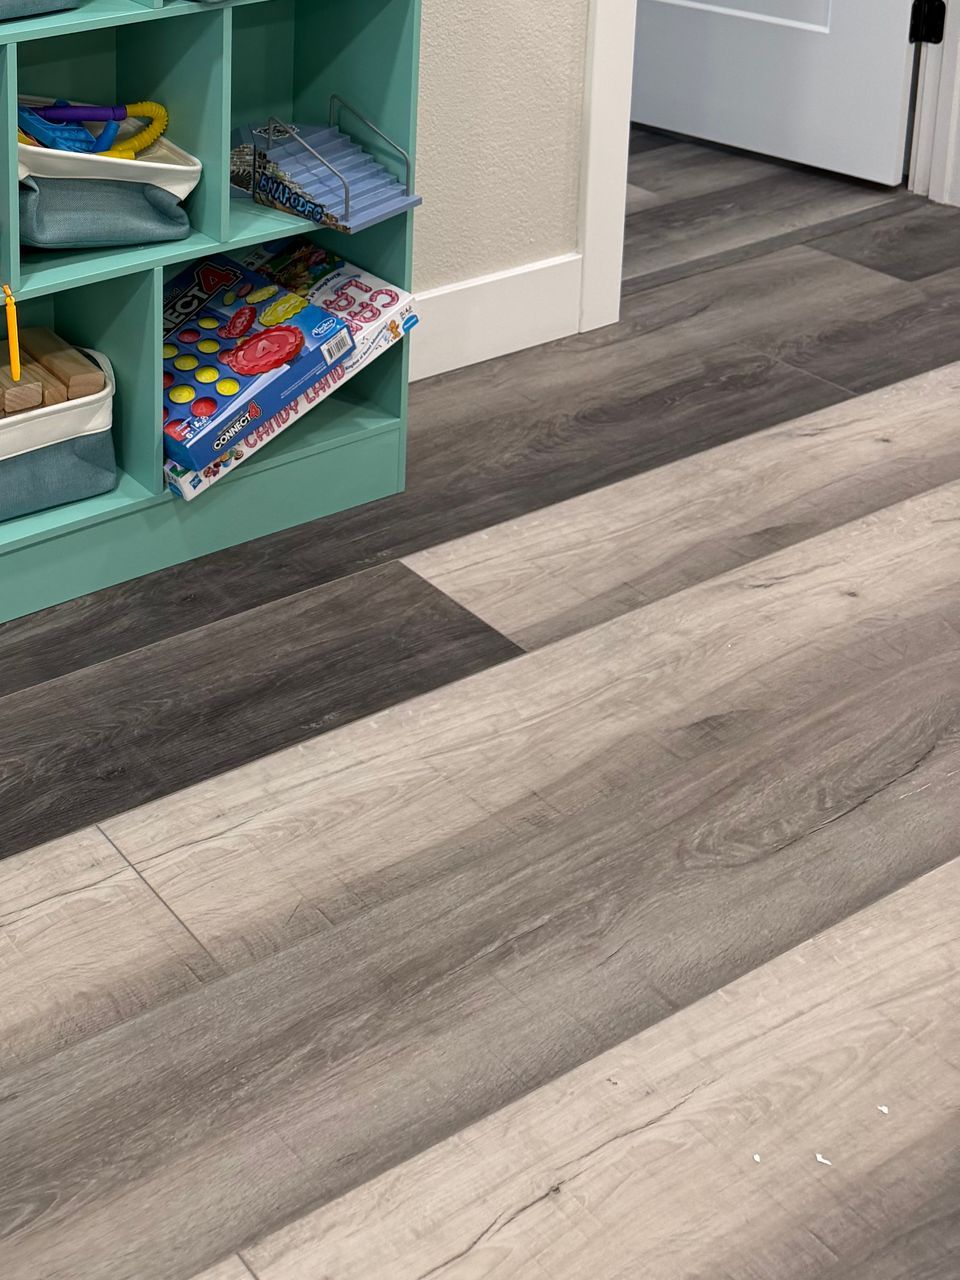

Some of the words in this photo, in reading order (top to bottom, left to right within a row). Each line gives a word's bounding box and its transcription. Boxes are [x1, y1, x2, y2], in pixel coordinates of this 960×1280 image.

[197, 263, 239, 296] 4
[323, 279, 372, 311] LA
[213, 413, 251, 450] CONNECT
[248, 401, 262, 419] 4
[243, 398, 299, 448] CANDY
[303, 364, 346, 404] LAND
